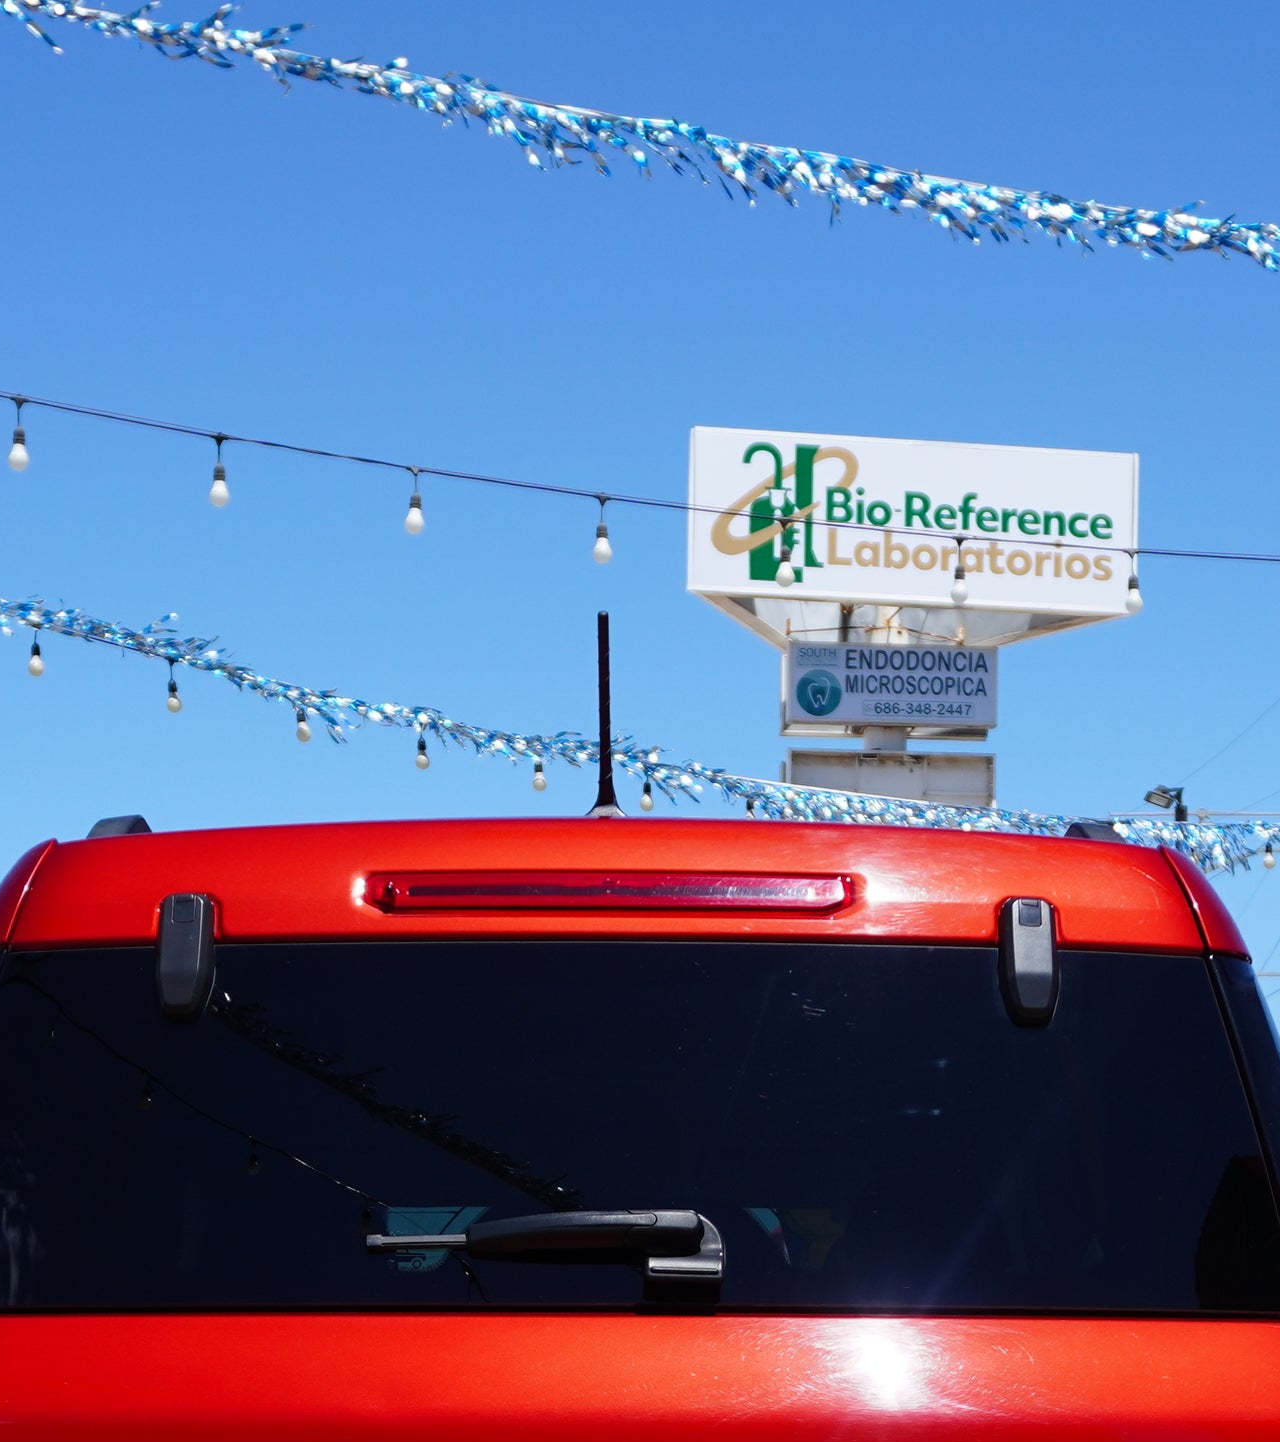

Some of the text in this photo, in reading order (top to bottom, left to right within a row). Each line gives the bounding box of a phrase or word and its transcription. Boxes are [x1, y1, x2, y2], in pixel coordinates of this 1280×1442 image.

[825, 486, 1113, 540] Bio-Reference
[826, 527, 1113, 581] Laboratorios
[799, 647, 837, 658] SOUTH
[845, 649, 989, 673] ENDODONCIA
[845, 674, 988, 697] MICROSCOPICA
[874, 702, 973, 716] 686-348-2447
